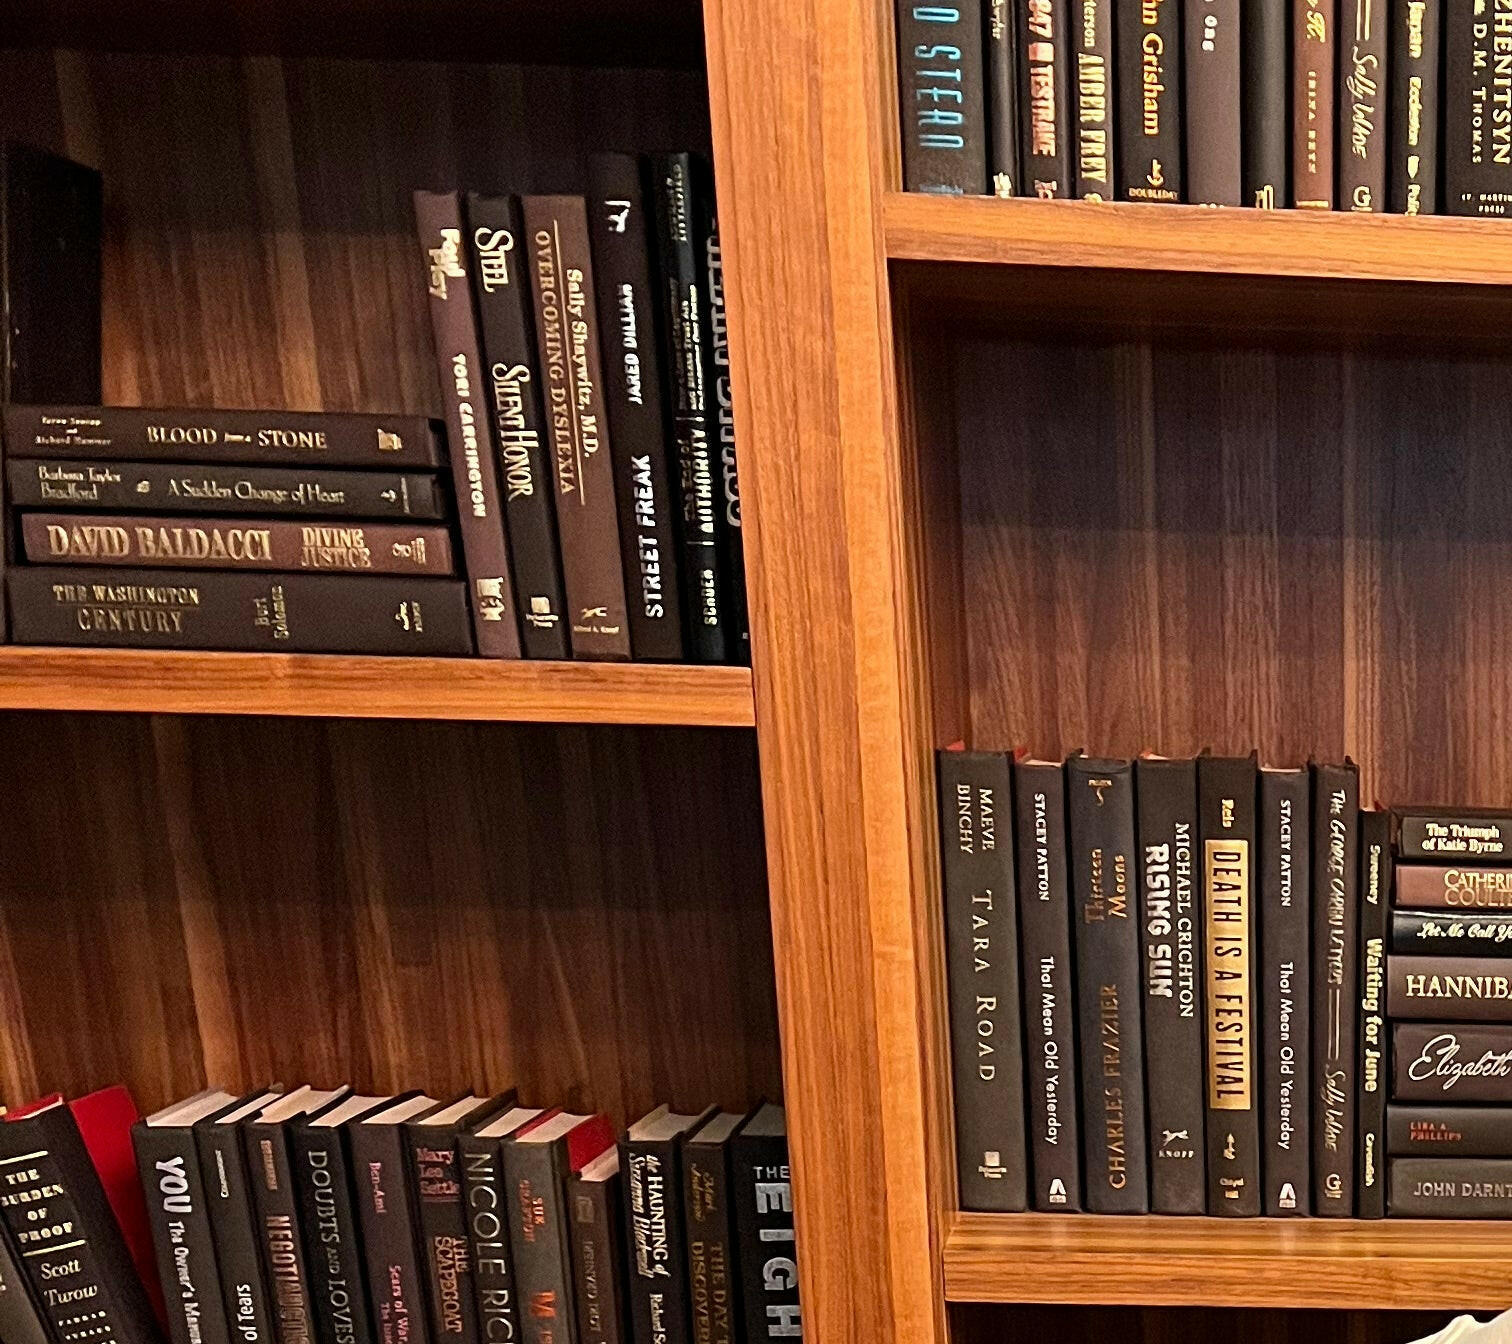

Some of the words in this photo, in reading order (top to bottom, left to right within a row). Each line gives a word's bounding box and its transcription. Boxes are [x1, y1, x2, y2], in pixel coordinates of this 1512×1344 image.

[1078, 53, 1105, 122] AMBER
[1142, 33, 1165, 135] Grisham
[1346, 46, 1378, 100] Sally
[1080, 130, 1107, 183] FREY
[535, 230, 566, 381] OVERCOMING
[566, 268, 583, 319] Sally
[451, 353, 470, 397] TORI
[568, 321, 592, 411] Shaywitz,
[147, 425, 218, 445] BLOOD
[257, 429, 328, 449] STONE
[550, 386, 575, 495] DYSLEXIA
[579, 414, 599, 458] M.D.
[458, 403, 486, 517] CARRINGTON
[40, 482, 97, 500] Bradford
[168, 479, 178, 496] A
[182, 479, 230, 498] Sudden
[235, 482, 289, 503] Change
[292, 477, 310, 504] of
[310, 485, 344, 505] Heart
[631, 455, 657, 527] FREAK
[46, 524, 129, 556] DAVID
[135, 527, 271, 560] BALDACCI
[301, 546, 371, 567] JUSTICE
[302, 527, 364, 548] DIVINE
[636, 534, 664, 619] STREET
[77, 607, 182, 632] CENTURY
[957, 784, 975, 855] BINCHY
[977, 787, 995, 851] MAEVE
[1426, 824, 1449, 838] The
[1450, 825, 1500, 839] Triumph
[1145, 844, 1171, 936] RISING
[1174, 823, 1192, 913] MICHAEL
[1212, 851, 1243, 924] DEATH
[1148, 944, 1173, 998] SUN
[1176, 917, 1194, 1017] CRICHTON
[1213, 936, 1238, 959] IS
[1214, 970, 1242, 981] A
[1362, 938, 1383, 1012] Waiting
[1103, 984, 1121, 1077] FRAZIER
[1215, 995, 1245, 1099] FESTIVAL
[1365, 1015, 1383, 1045] for
[1365, 1050, 1381, 1093] June
[1103, 1086, 1127, 1190] CHARLES
[5, 1169, 40, 1184] THE
[753, 1166, 789, 1179] THE
[1413, 1181, 1455, 1197] JOHN
[18, 1222, 73, 1243] PROOF
[27, 1208, 48, 1221] OF
[464, 1153, 505, 1275] NICOLE
[41, 1258, 81, 1279] Scott
[44, 1284, 98, 1307] Turow
[237, 1284, 251, 1323] Tears
[246, 1322, 258, 1340] of
